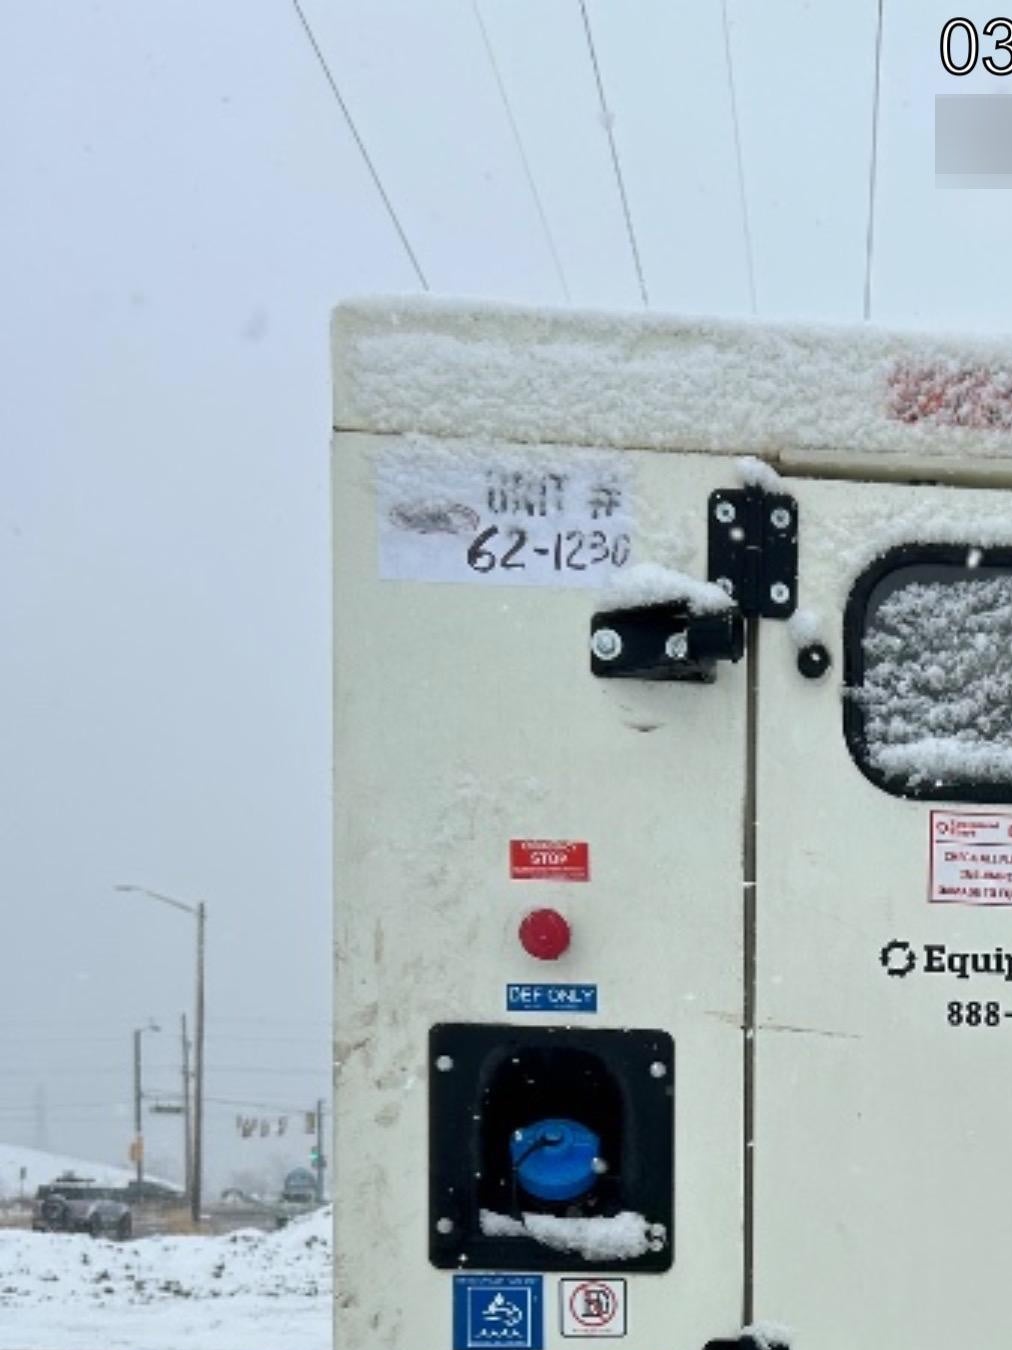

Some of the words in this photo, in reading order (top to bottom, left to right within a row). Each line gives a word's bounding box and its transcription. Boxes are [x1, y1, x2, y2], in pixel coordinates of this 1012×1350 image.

[529, 851, 568, 866] STOP
[509, 986, 542, 1003] DEF
[549, 988, 594, 1004] ONLY
